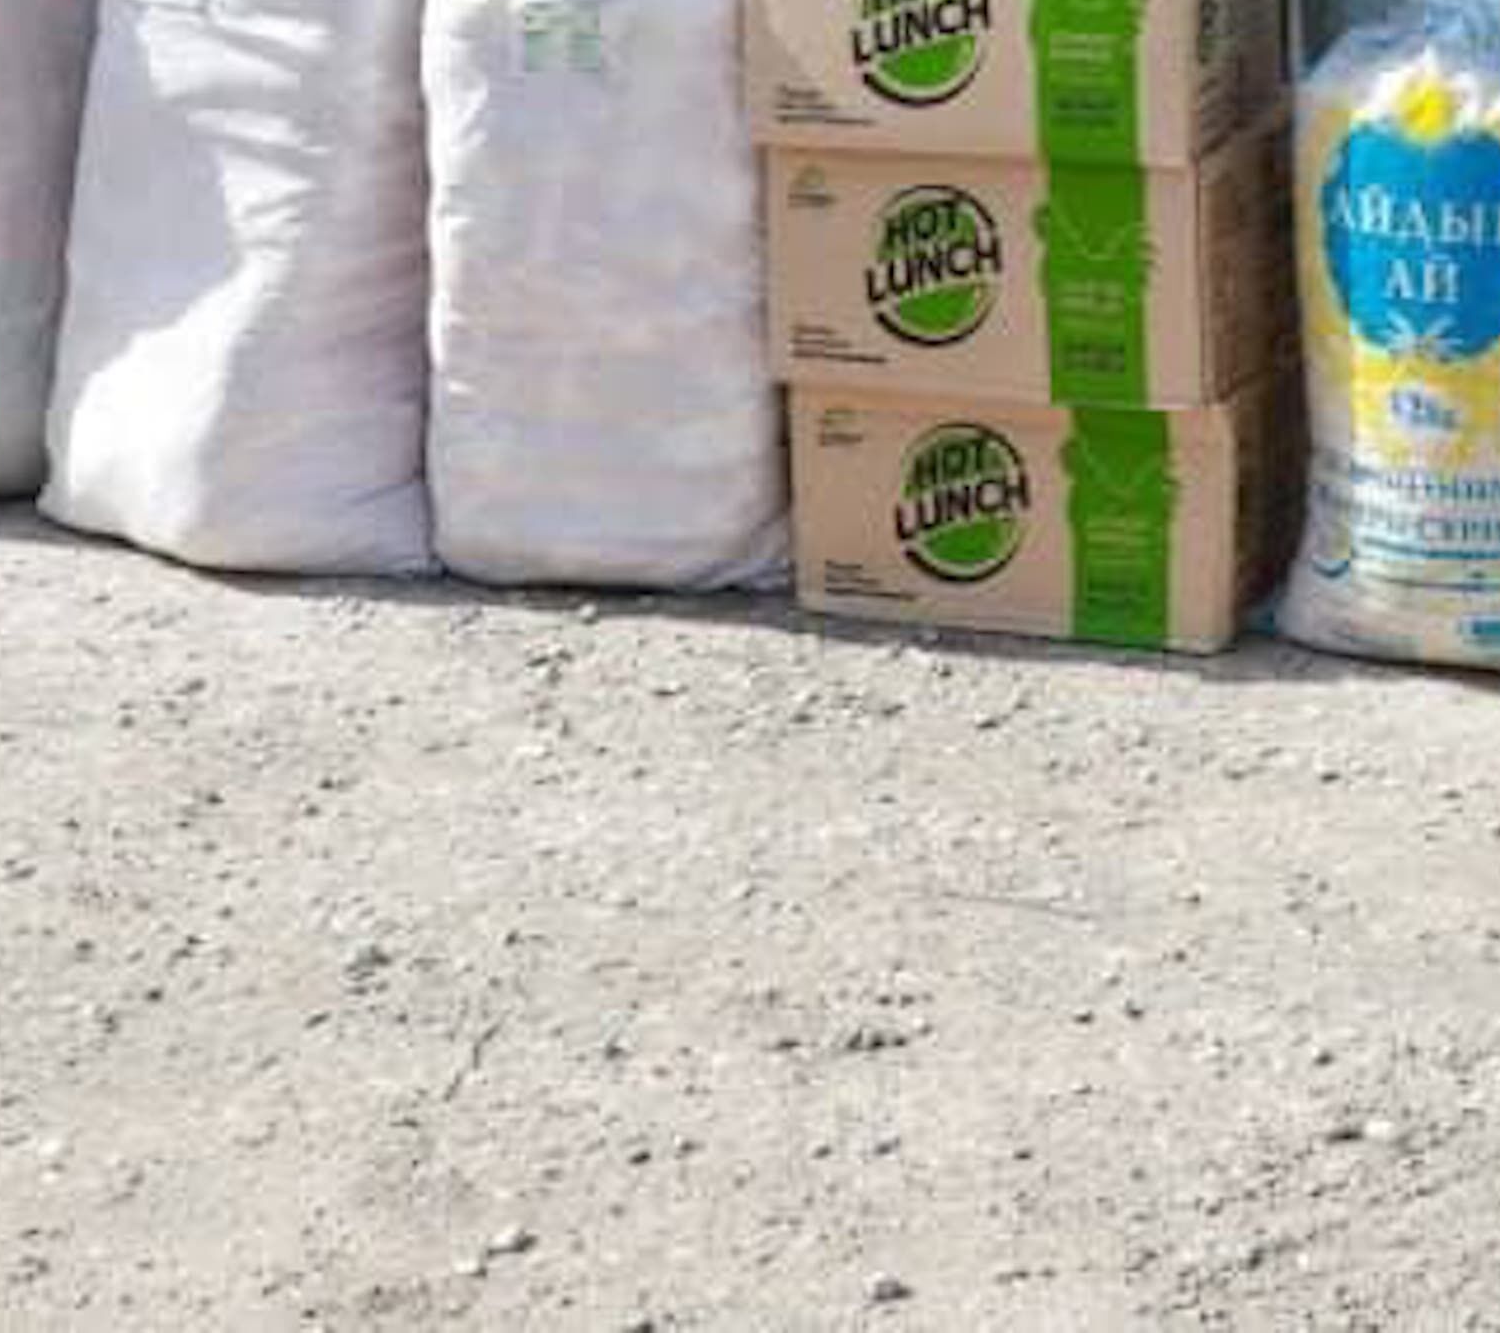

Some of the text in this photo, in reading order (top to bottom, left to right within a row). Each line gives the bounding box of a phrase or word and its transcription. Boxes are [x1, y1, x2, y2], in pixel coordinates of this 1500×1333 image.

[884, 198, 959, 239] HOT
[865, 232, 1002, 306] LUNCH
[1384, 253, 1460, 304] АЙ
[912, 438, 987, 481] HOT
[895, 469, 1031, 541] LUNCH
